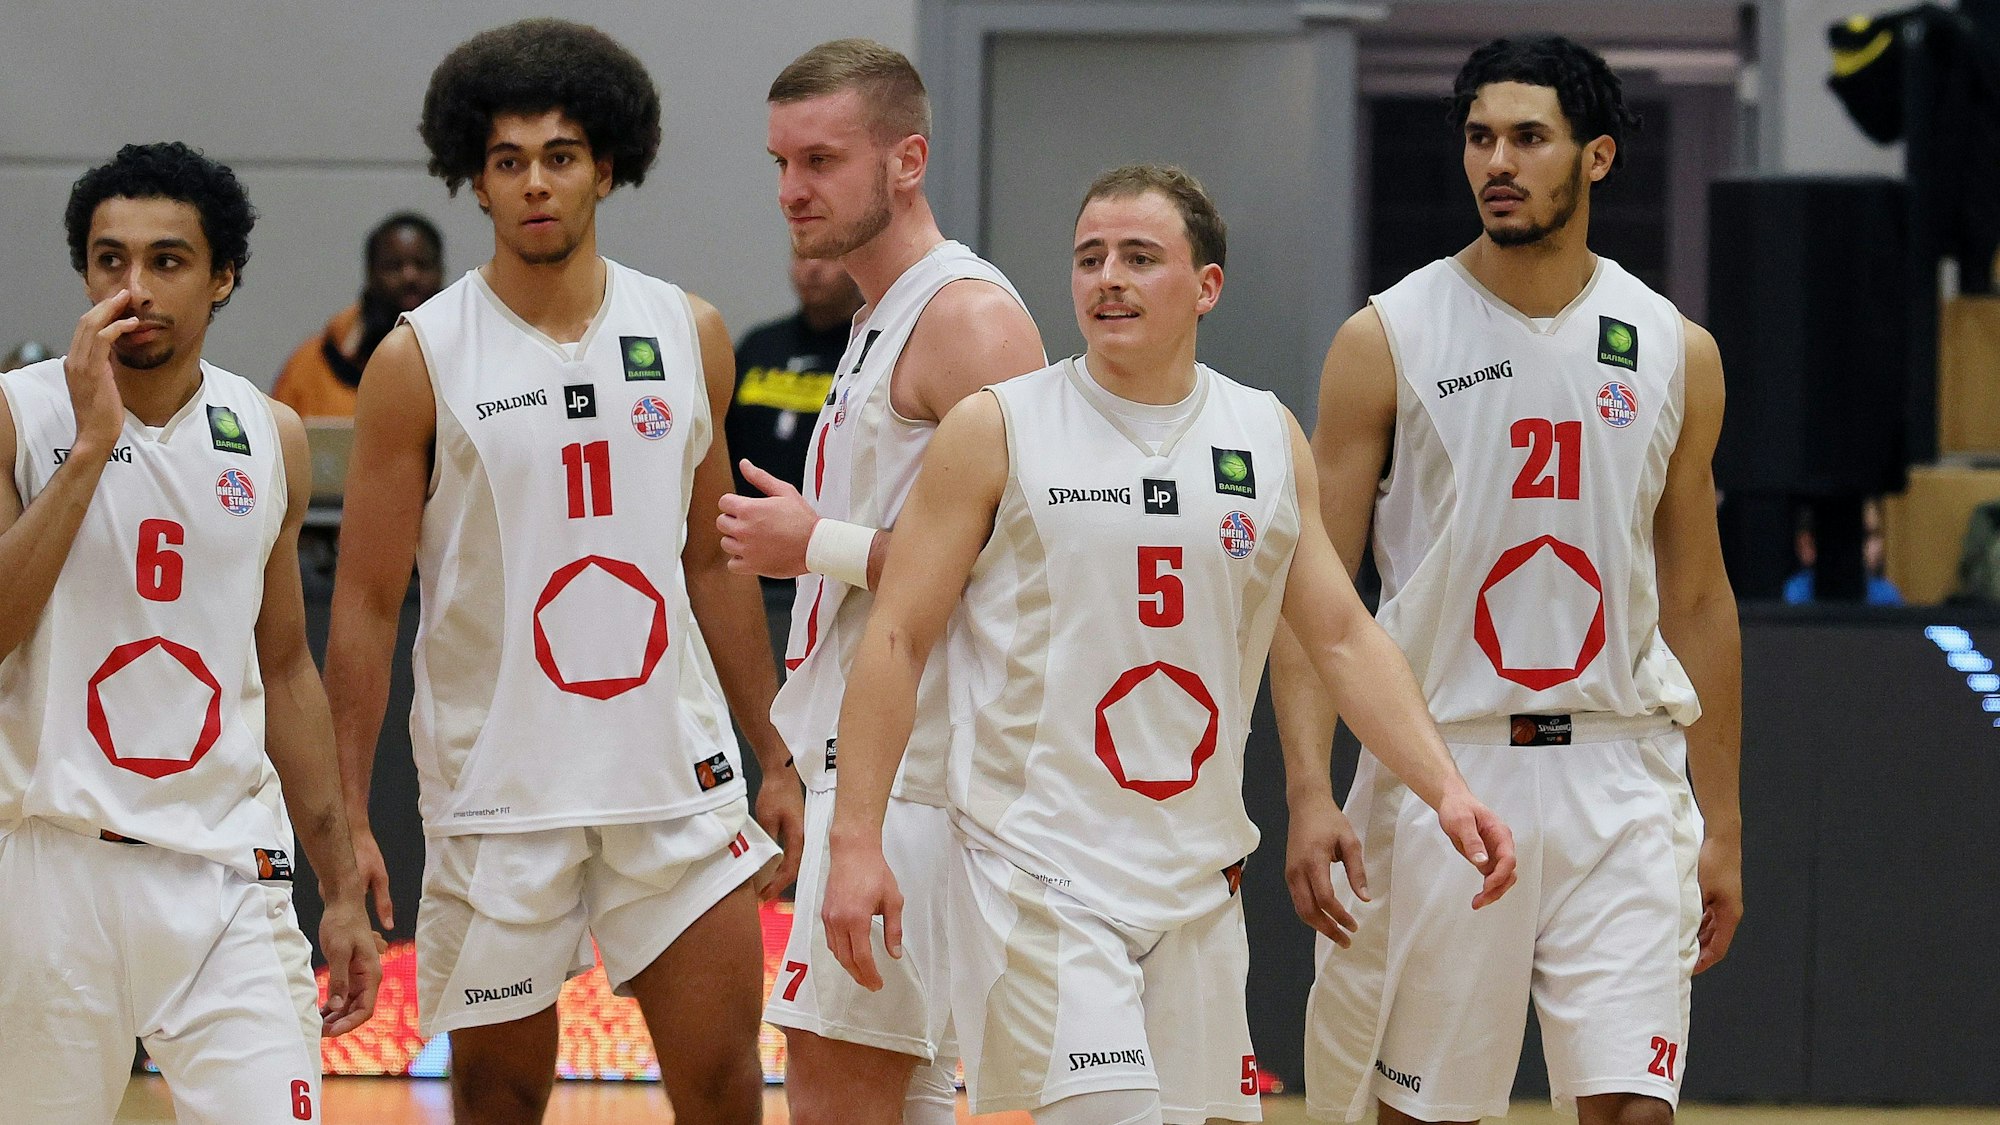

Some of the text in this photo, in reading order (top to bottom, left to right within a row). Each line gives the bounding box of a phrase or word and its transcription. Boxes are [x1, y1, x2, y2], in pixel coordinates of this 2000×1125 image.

[1601, 353, 1634, 368] BARMER
[1437, 360, 1513, 399] SPALDING
[476, 389, 547, 420] SPALDING
[1598, 397, 1623, 409] RHEIN
[1609, 407, 1635, 420] STARS
[646, 420, 671, 430] STARS
[216, 439, 247, 450] BARMER
[1510, 418, 1582, 501] 21
[561, 440, 613, 519] 11
[1218, 482, 1252, 494] BARMER
[217, 486, 241, 496] RHEIN
[1048, 487, 1131, 505] SPALDING
[229, 496, 254, 507] STARS
[1221, 528, 1243, 538] RHEIN
[1231, 539, 1254, 550] STARS
[136, 518, 184, 602] 6
[1137, 545, 1184, 628] 5
[1059, 879, 1071, 887] FIT
[782, 960, 808, 1002] 7
[465, 978, 533, 1005] SPALDING
[1069, 1049, 1145, 1072] SPALDING
[1648, 1036, 1678, 1081] 21
[1241, 1055, 1258, 1096] 5
[290, 1079, 312, 1121] 6
